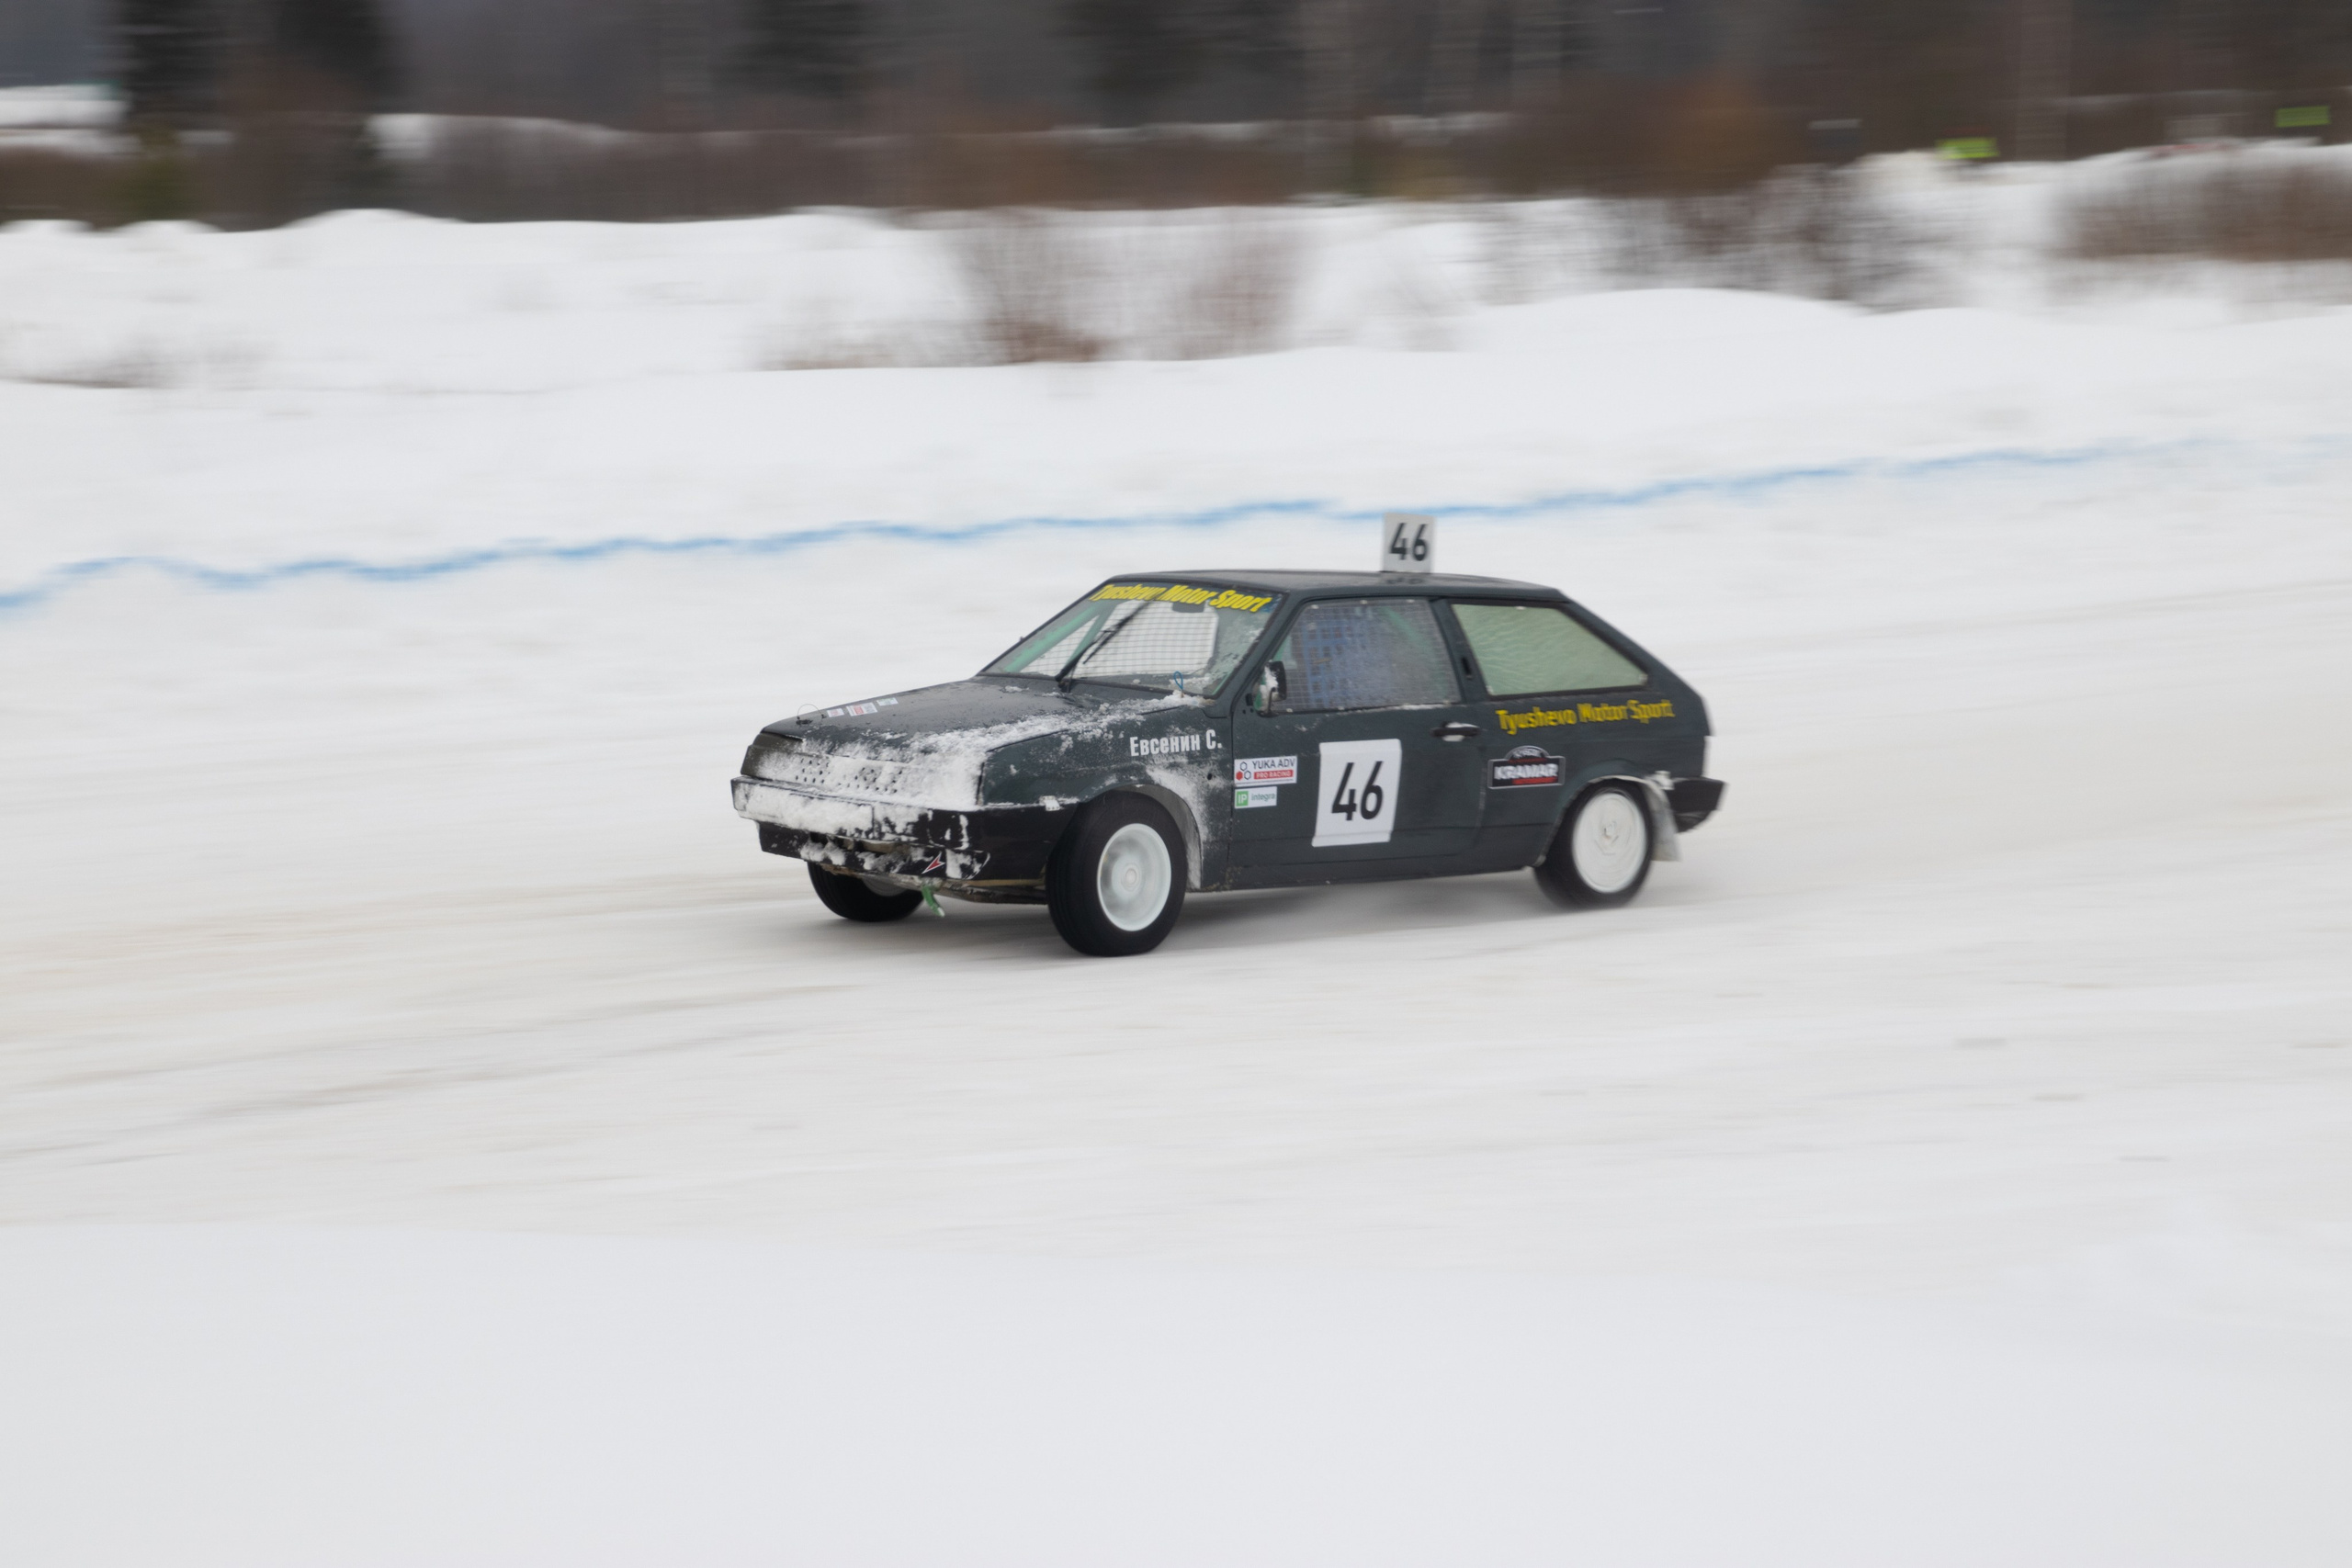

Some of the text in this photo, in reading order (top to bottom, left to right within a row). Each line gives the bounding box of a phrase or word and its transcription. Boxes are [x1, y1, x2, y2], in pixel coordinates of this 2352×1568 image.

[1389, 522, 1429, 561] 46
[1156, 584, 1218, 604] Motor
[1209, 589, 1272, 613] Sport
[1495, 699, 1675, 735] Tyushevo Motor Sport
[1129, 729, 1223, 757] Евсенин С.
[1252, 758, 1295, 770] YUKA ADV
[1331, 761, 1384, 821] 46
